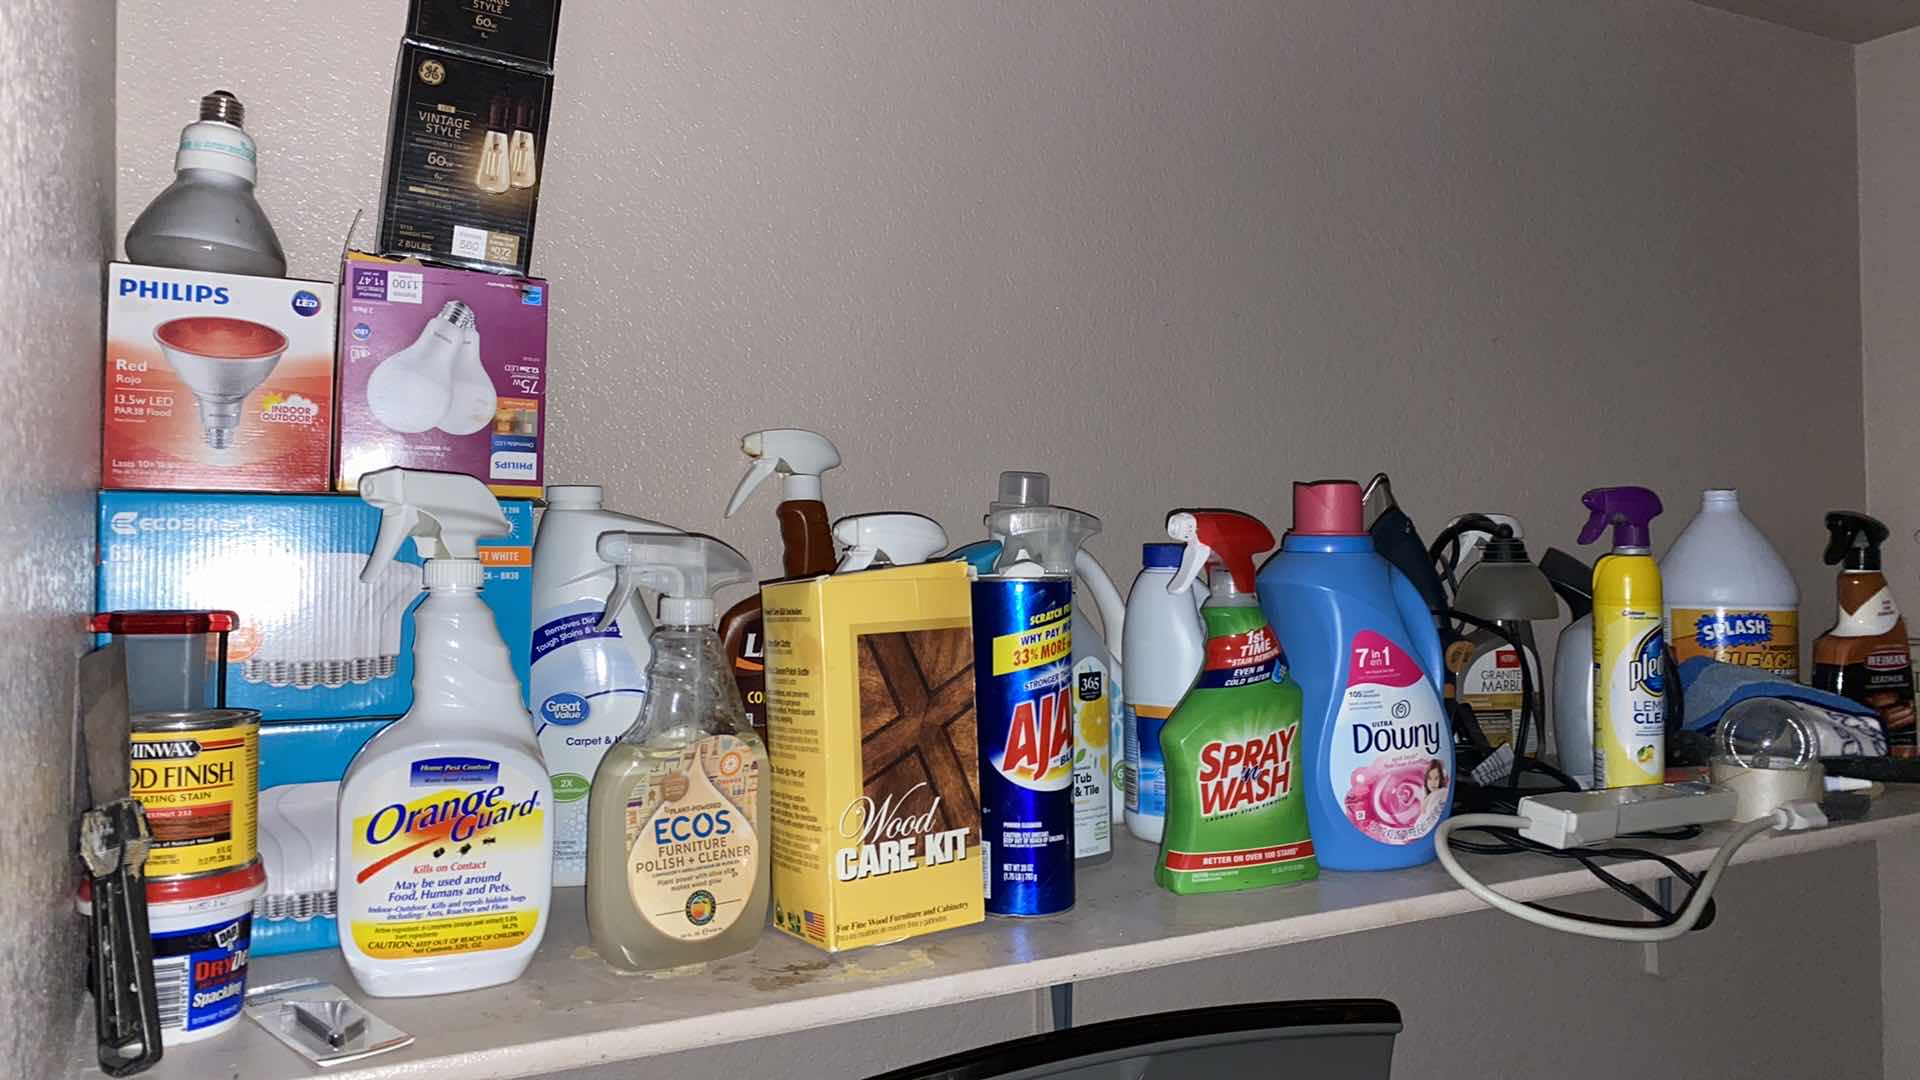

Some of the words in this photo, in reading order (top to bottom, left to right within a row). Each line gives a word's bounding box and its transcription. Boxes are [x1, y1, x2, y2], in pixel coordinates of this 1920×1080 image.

[473, 0, 504, 14] STYLE
[418, 111, 472, 130] VINTAGE
[425, 123, 462, 138] STYLE
[405, 239, 433, 252] BULBS
[119, 278, 230, 305] PHILIPS
[295, 297, 318, 308] LED
[116, 359, 148, 372] Red
[116, 374, 142, 385] Rojo
[149, 396, 174, 407] LED
[147, 408, 172, 417] Flood
[271, 405, 312, 415] INDOOR
[262, 413, 311, 424] OUTDOOR
[495, 461, 534, 471] PHILIPS
[491, 551, 520, 561] WHITE
[1030, 608, 1062, 625] SCRATCH
[544, 616, 581, 637] Removes
[582, 616, 596, 625] Dirt
[1702, 619, 1766, 641] SPLASH
[536, 633, 559, 653] Tough
[560, 627, 584, 640] Stains
[1020, 633, 1043, 646] WHY
[1046, 627, 1060, 640] PAY
[1247, 630, 1265, 645] 1st
[1013, 648, 1039, 667] 33%
[1040, 638, 1066, 660] MORE
[1240, 638, 1272, 658] TIME
[1355, 648, 1369, 668] 7
[1233, 666, 1256, 677] EVEN
[1256, 665, 1265, 673] IN
[1480, 669, 1522, 680] GRANITE
[1024, 672, 1060, 691] STRONGER
[1080, 676, 1100, 692] 365
[1224, 678, 1246, 687] COLD
[1247, 672, 1271, 683] WATER
[1481, 680, 1521, 693] MARBL
[1871, 675, 1904, 684] LEATHER
[546, 700, 582, 712] Great
[1634, 700, 1664, 712] LEM
[554, 710, 581, 719] Value
[1633, 712, 1664, 724] CLE
[1372, 720, 1393, 728] ULTRA
[566, 736, 602, 747] Carpet
[605, 736, 612, 744] &
[1001, 687, 1073, 782] AJA
[1352, 722, 1440, 755] Downy
[1198, 722, 1299, 782] SPRAY
[445, 763, 462, 771] Pest
[463, 763, 492, 771] Control
[131, 767, 158, 789] OD
[164, 761, 234, 788] FINISH
[1074, 773, 1092, 784] Tub
[560, 778, 574, 788] 2X
[1200, 761, 1291, 816] WASH
[180, 791, 211, 801] STAIN
[1074, 786, 1082, 797] &
[1084, 785, 1100, 796] Tile
[366, 785, 505, 845] Orange
[450, 790, 539, 843] Guard
[839, 782, 940, 847] Wood
[1241, 806, 1260, 815] STAIN
[654, 810, 732, 845] ECOS
[658, 837, 728, 858] FURNITURE
[836, 837, 918, 881] CARE
[925, 827, 970, 866] KIT
[636, 856, 685, 873] POLISH
[698, 845, 752, 863] CLEANER
[1202, 855, 1232, 865] BETTER
[1233, 855, 1244, 863] ON
[1245, 853, 1263, 861] OVER
[1264, 851, 1276, 859] 100
[413, 864, 433, 875] Kills
[450, 860, 487, 871] Contact
[1003, 863, 1012, 872] NET
[394, 880, 417, 892] May
[421, 878, 433, 888] be
[438, 875, 463, 886] used
[464, 872, 502, 885] around
[657, 877, 674, 886] Plant
[675, 875, 694, 884] power
[695, 872, 708, 880] with
[388, 890, 418, 902] Food,
[420, 888, 464, 900] Humans
[466, 884, 487, 895] and
[489, 883, 512, 894] Pets.
[431, 902, 447, 910] Kills
[447, 906, 475, 915] Roaches
[836, 923, 849, 933] For
[851, 920, 867, 930] Fine
[867, 916, 890, 927] Wood
[890, 911, 922, 923] Furniture
[923, 906, 936, 915] and
[937, 902, 969, 913] Cabinetry
[368, 940, 414, 950] CAUTION:
[460, 935, 481, 943] REACH
[493, 931, 524, 939] CHILDREN
